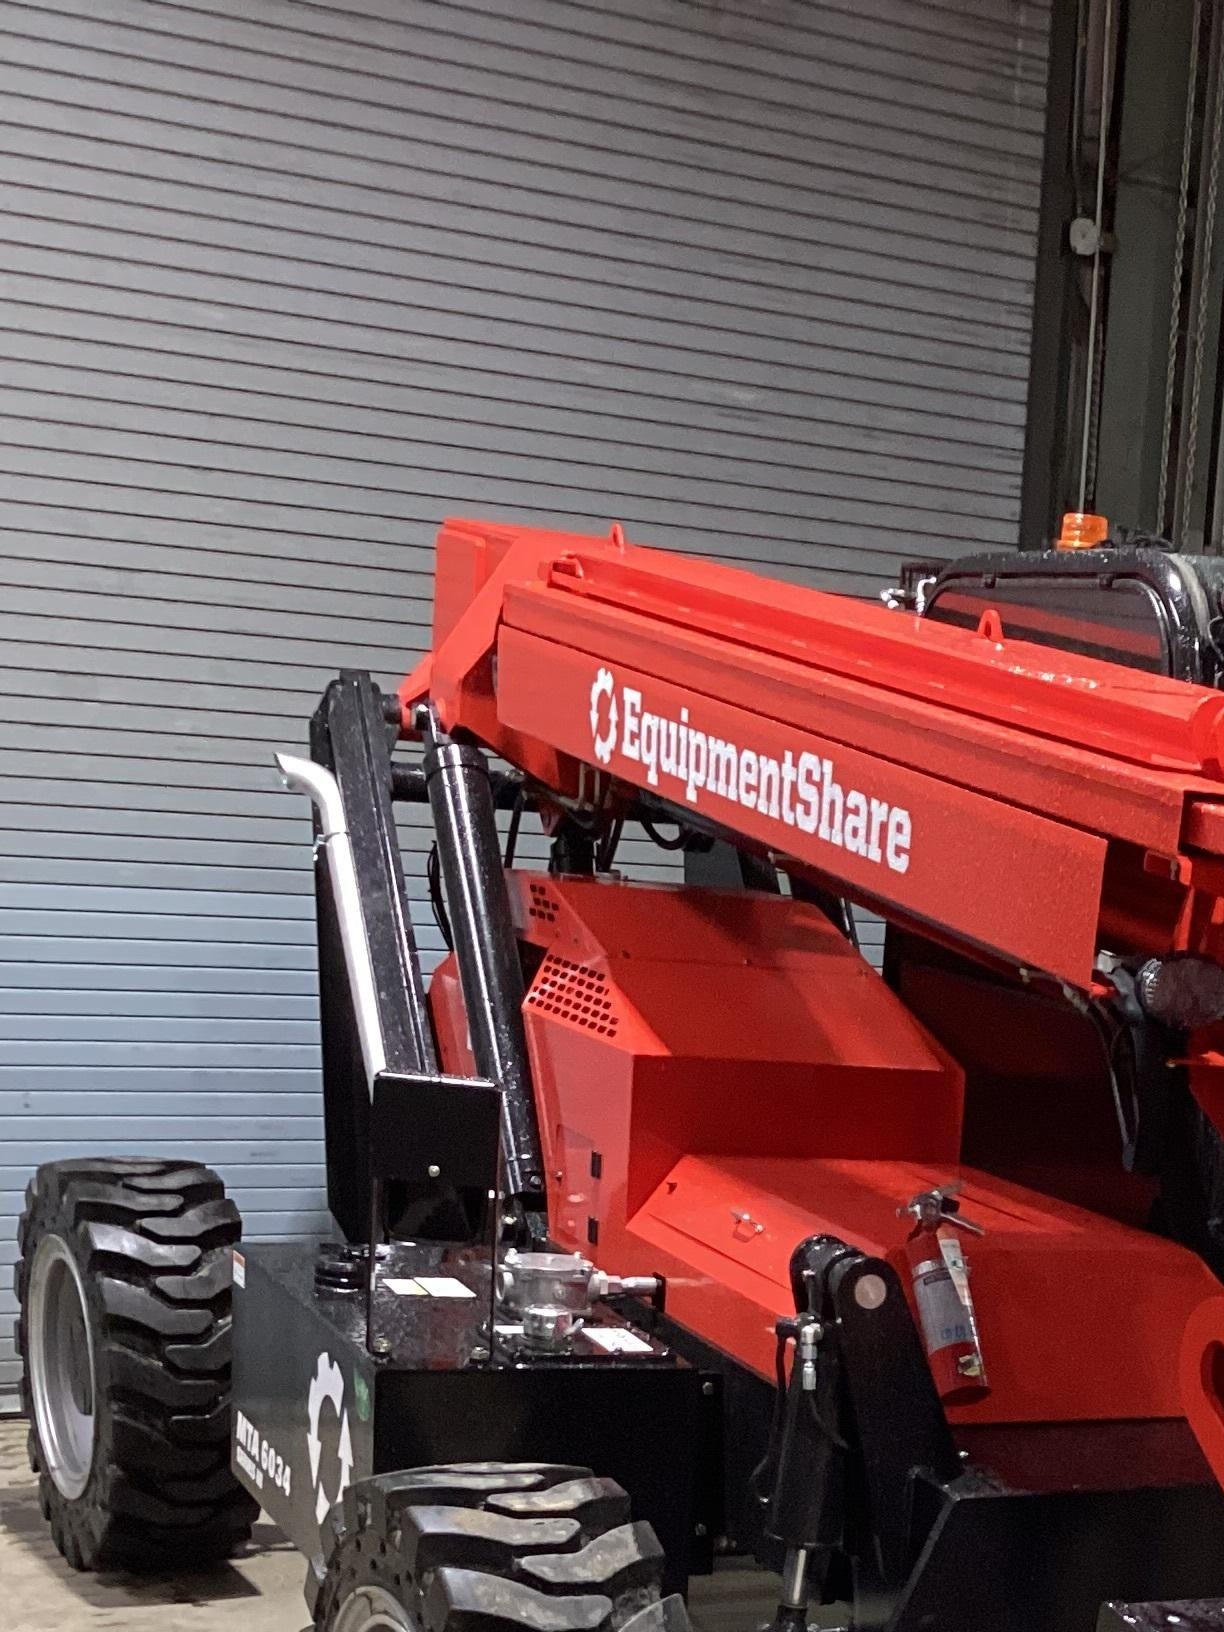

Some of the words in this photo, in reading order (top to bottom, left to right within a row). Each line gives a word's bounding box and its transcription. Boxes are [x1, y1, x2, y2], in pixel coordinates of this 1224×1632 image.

[621, 686, 913, 875] EquipmentShare
[236, 1410, 260, 1463] MTA
[260, 1439, 292, 1497] 6034
